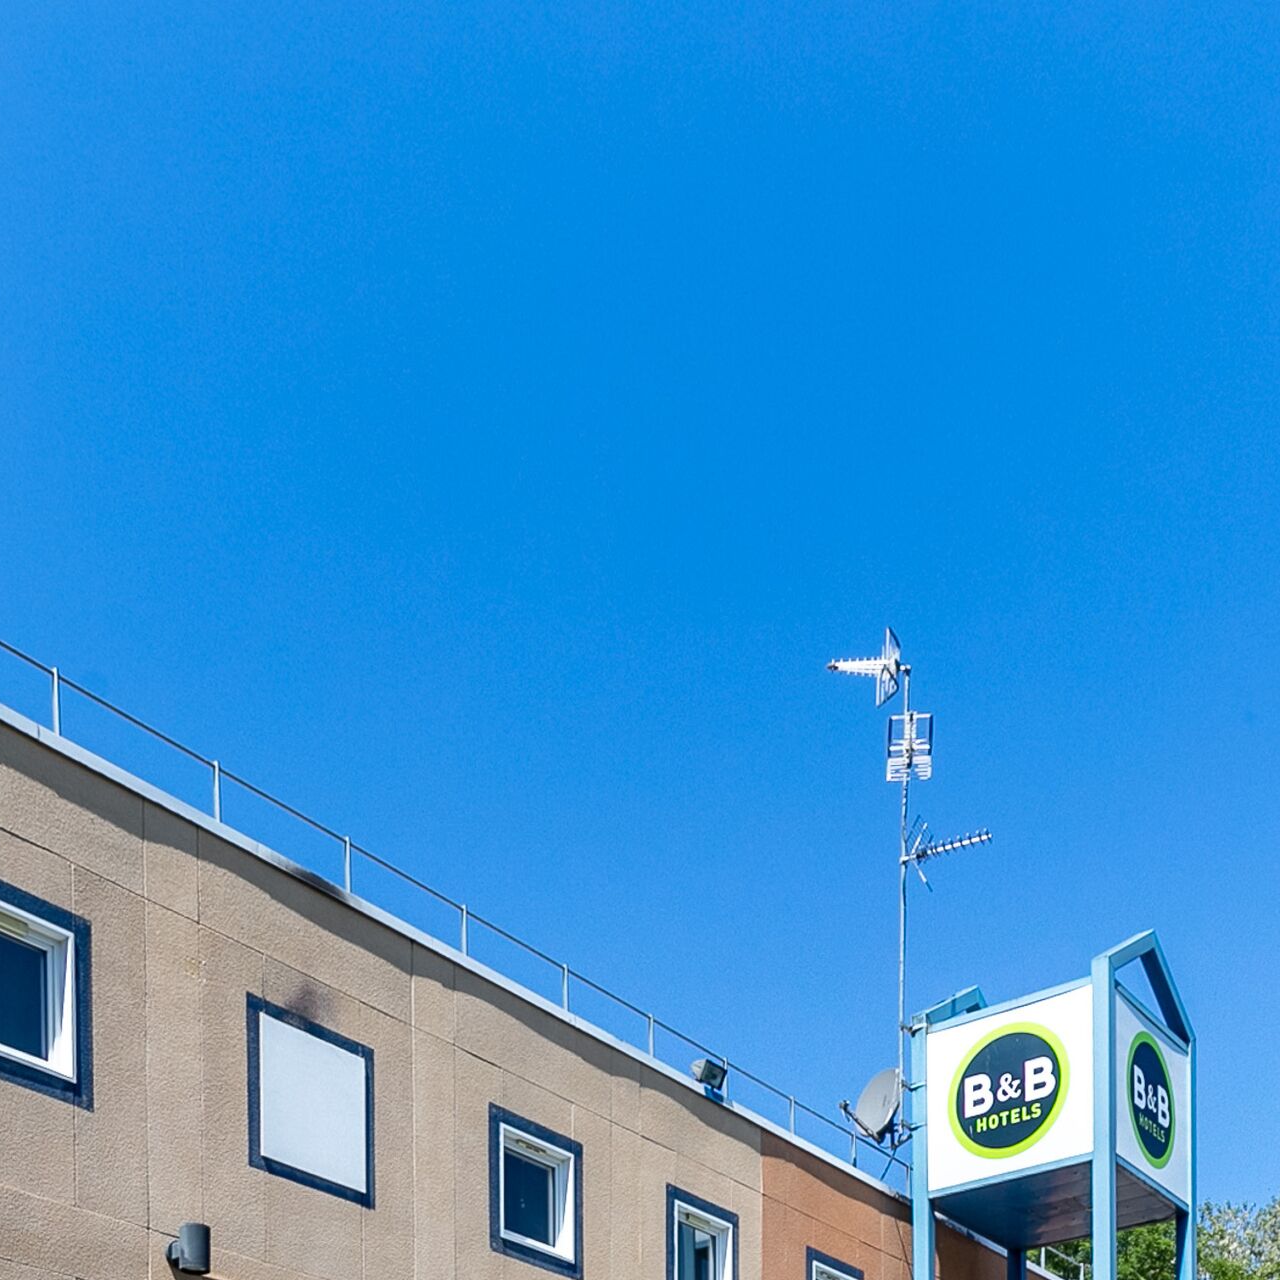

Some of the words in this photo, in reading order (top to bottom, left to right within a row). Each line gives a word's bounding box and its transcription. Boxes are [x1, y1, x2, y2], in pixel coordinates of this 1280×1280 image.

[964, 1056, 1056, 1119] B&B
[1133, 1064, 1170, 1128] B&B
[976, 1102, 1041, 1133] HOTELS
[1139, 1112, 1166, 1143] HOTELS
